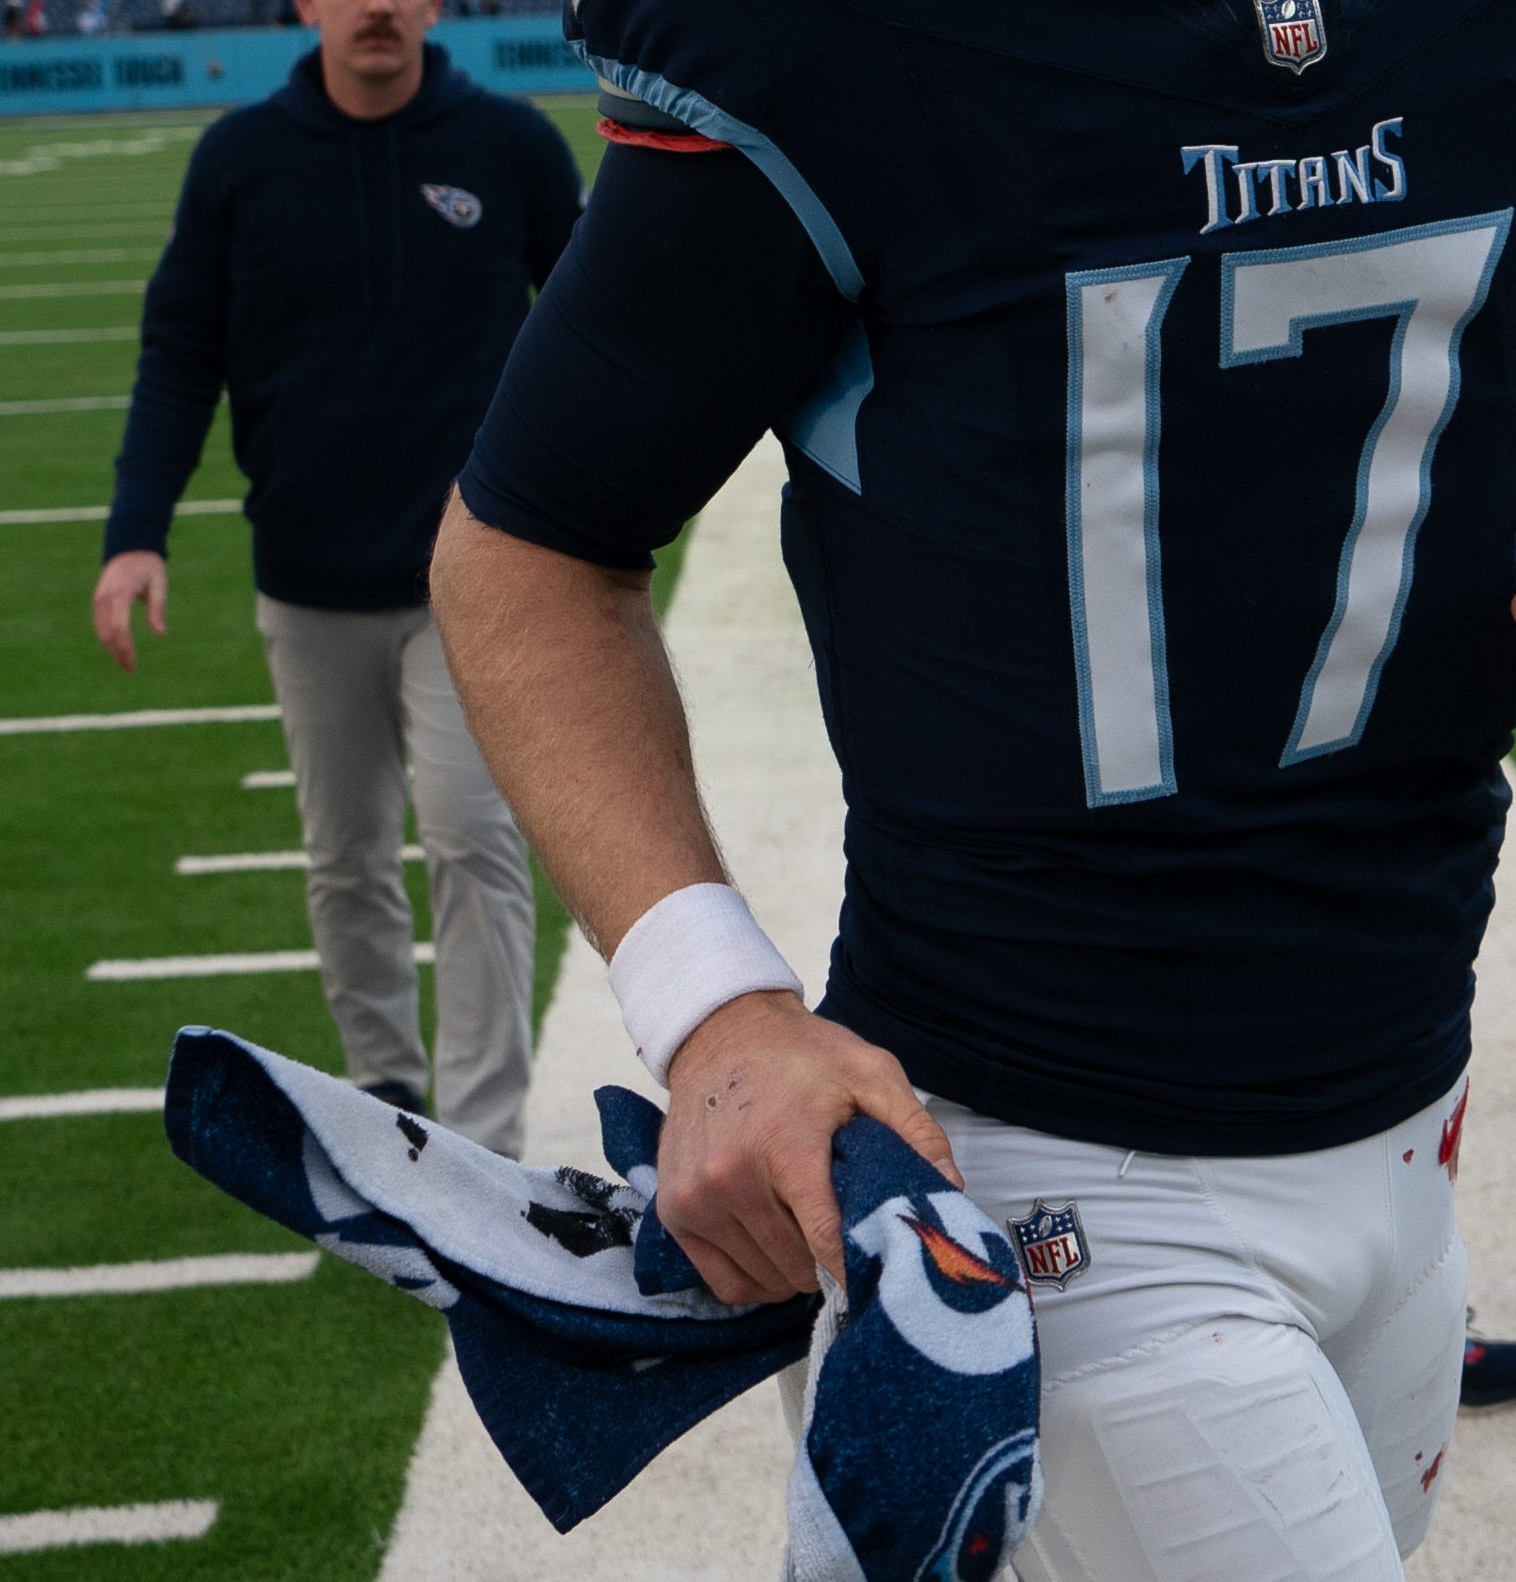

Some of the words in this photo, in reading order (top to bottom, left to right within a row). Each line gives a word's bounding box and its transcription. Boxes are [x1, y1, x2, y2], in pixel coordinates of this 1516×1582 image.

[1272, 23, 1319, 58] NFL
[1181, 116, 1408, 234] TITANS
[1064, 206, 1514, 808] 17
[1026, 1236, 1080, 1275] NFL
